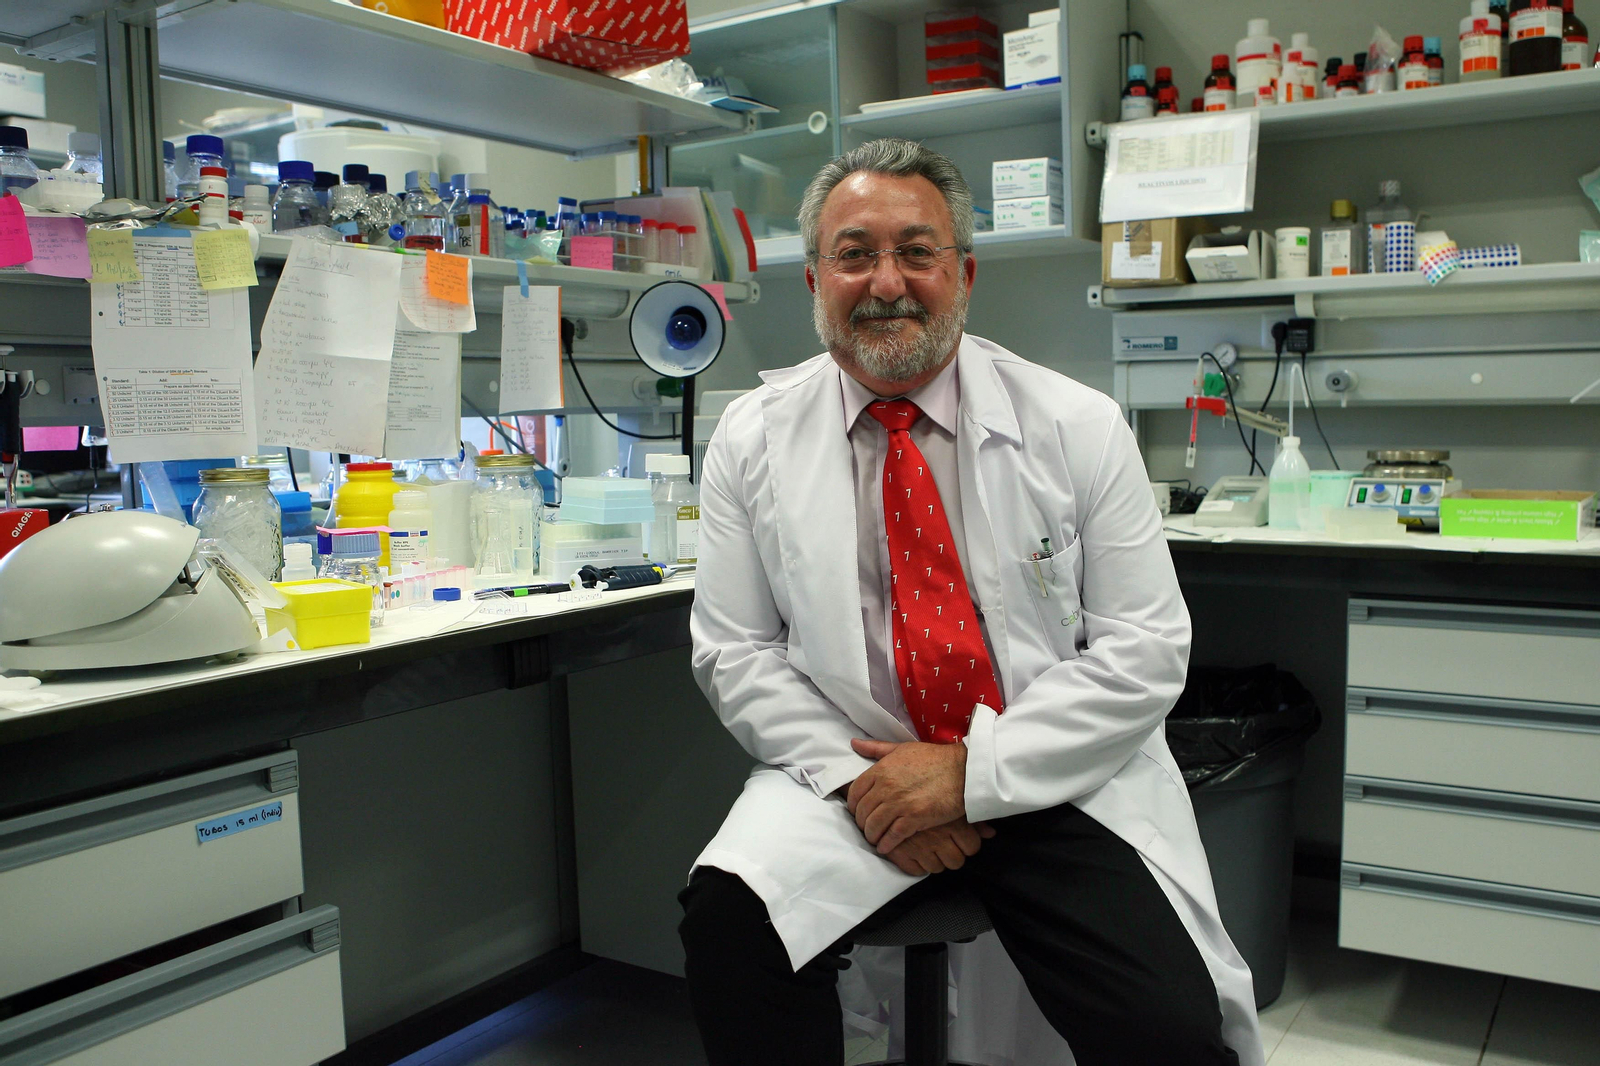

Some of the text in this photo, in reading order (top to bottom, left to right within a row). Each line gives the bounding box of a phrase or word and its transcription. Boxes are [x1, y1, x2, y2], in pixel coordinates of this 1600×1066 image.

[563, 6, 578, 28] QIAGEN
[619, 11, 635, 30] QIAGEN
[504, 14, 514, 38] QIAGEN
[600, 17, 615, 37] QIAGEN
[652, 23, 667, 42] QIAGEN
[519, 26, 529, 50] QIAGEN
[896, 449, 902, 459] 7
[917, 466, 923, 476] 7
[905, 488, 911, 498] 7
[928, 504, 933, 514] 7
[895, 511, 900, 521] 7
[916, 528, 921, 537] 7
[938, 543, 944, 553] 7
[904, 551, 910, 561] 7
[926, 567, 932, 576] 7
[893, 574, 897, 584] 7
[948, 583, 954, 592] 7
[914, 590, 920, 600] 7
[936, 606, 942, 615] 7
[902, 613, 907, 622] 7
[959, 621, 964, 630] 7
[924, 628, 930, 638] 7
[946, 643, 952, 653] 7
[911, 651, 916, 661] 7
[969, 659, 975, 669] 7
[934, 666, 939, 676] 7
[957, 682, 962, 691] 7
[920, 690, 926, 699] 7
[979, 694, 985, 702] 7
[943, 704, 949, 712] 7
[930, 725, 936, 734] 7
[236, 818, 245, 828] 15
[248, 813, 259, 824] ml
[261, 806, 283, 821] (indiv)
